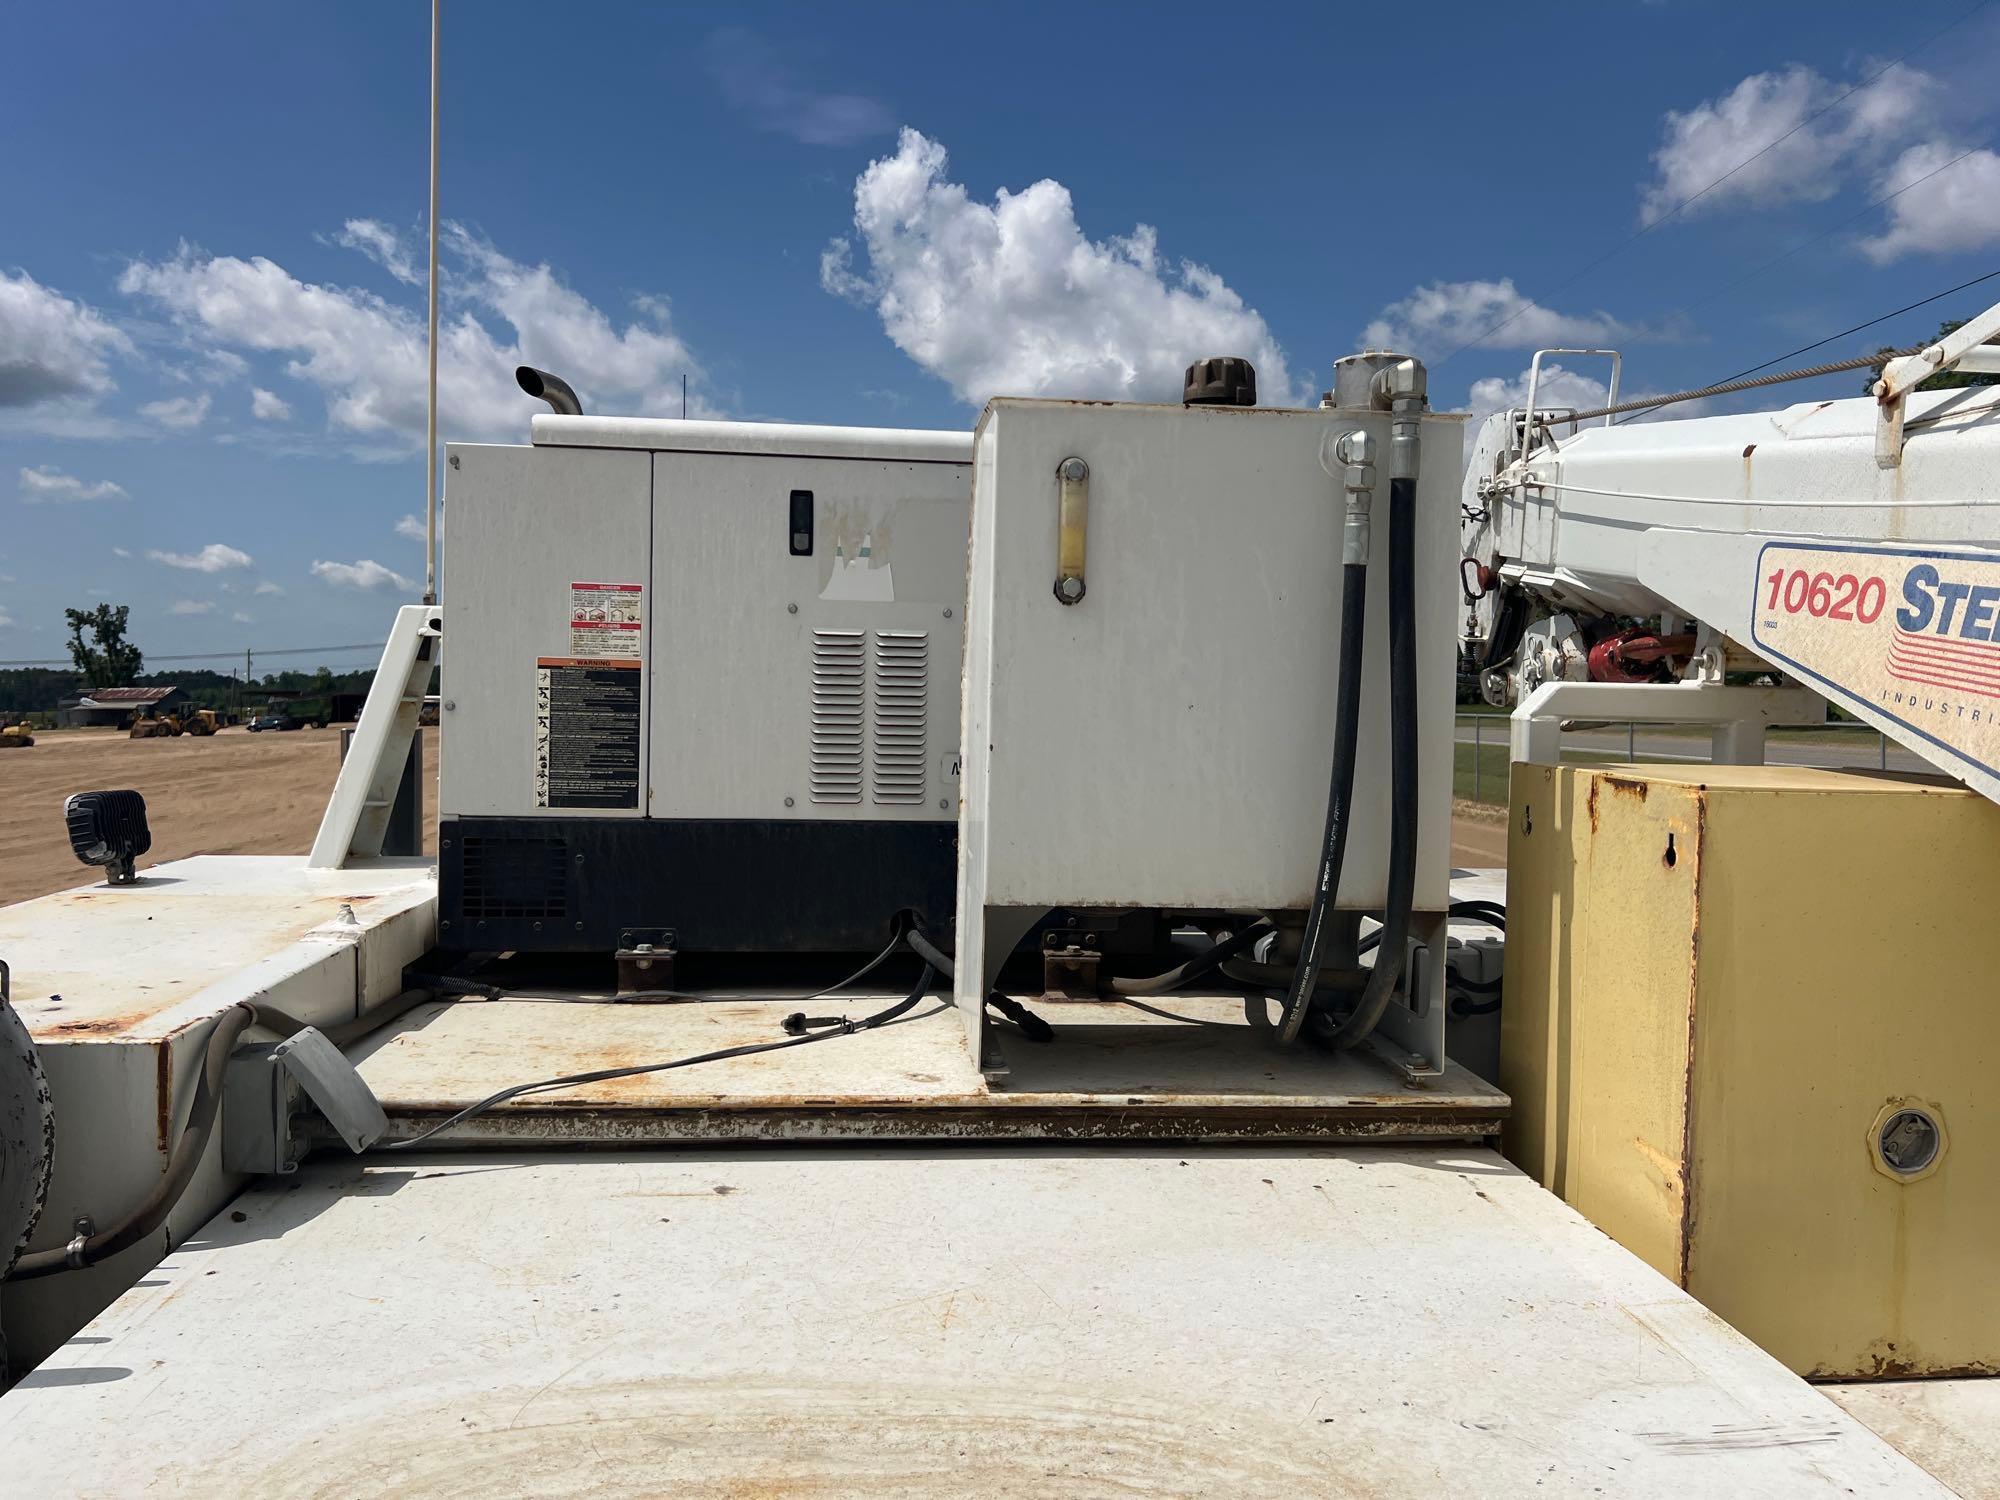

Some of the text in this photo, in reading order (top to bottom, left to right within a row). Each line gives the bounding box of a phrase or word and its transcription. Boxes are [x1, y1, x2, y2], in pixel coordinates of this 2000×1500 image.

[1768, 564, 2000, 642] 10620 STE
[1883, 690, 2000, 725] INDUSTRI
